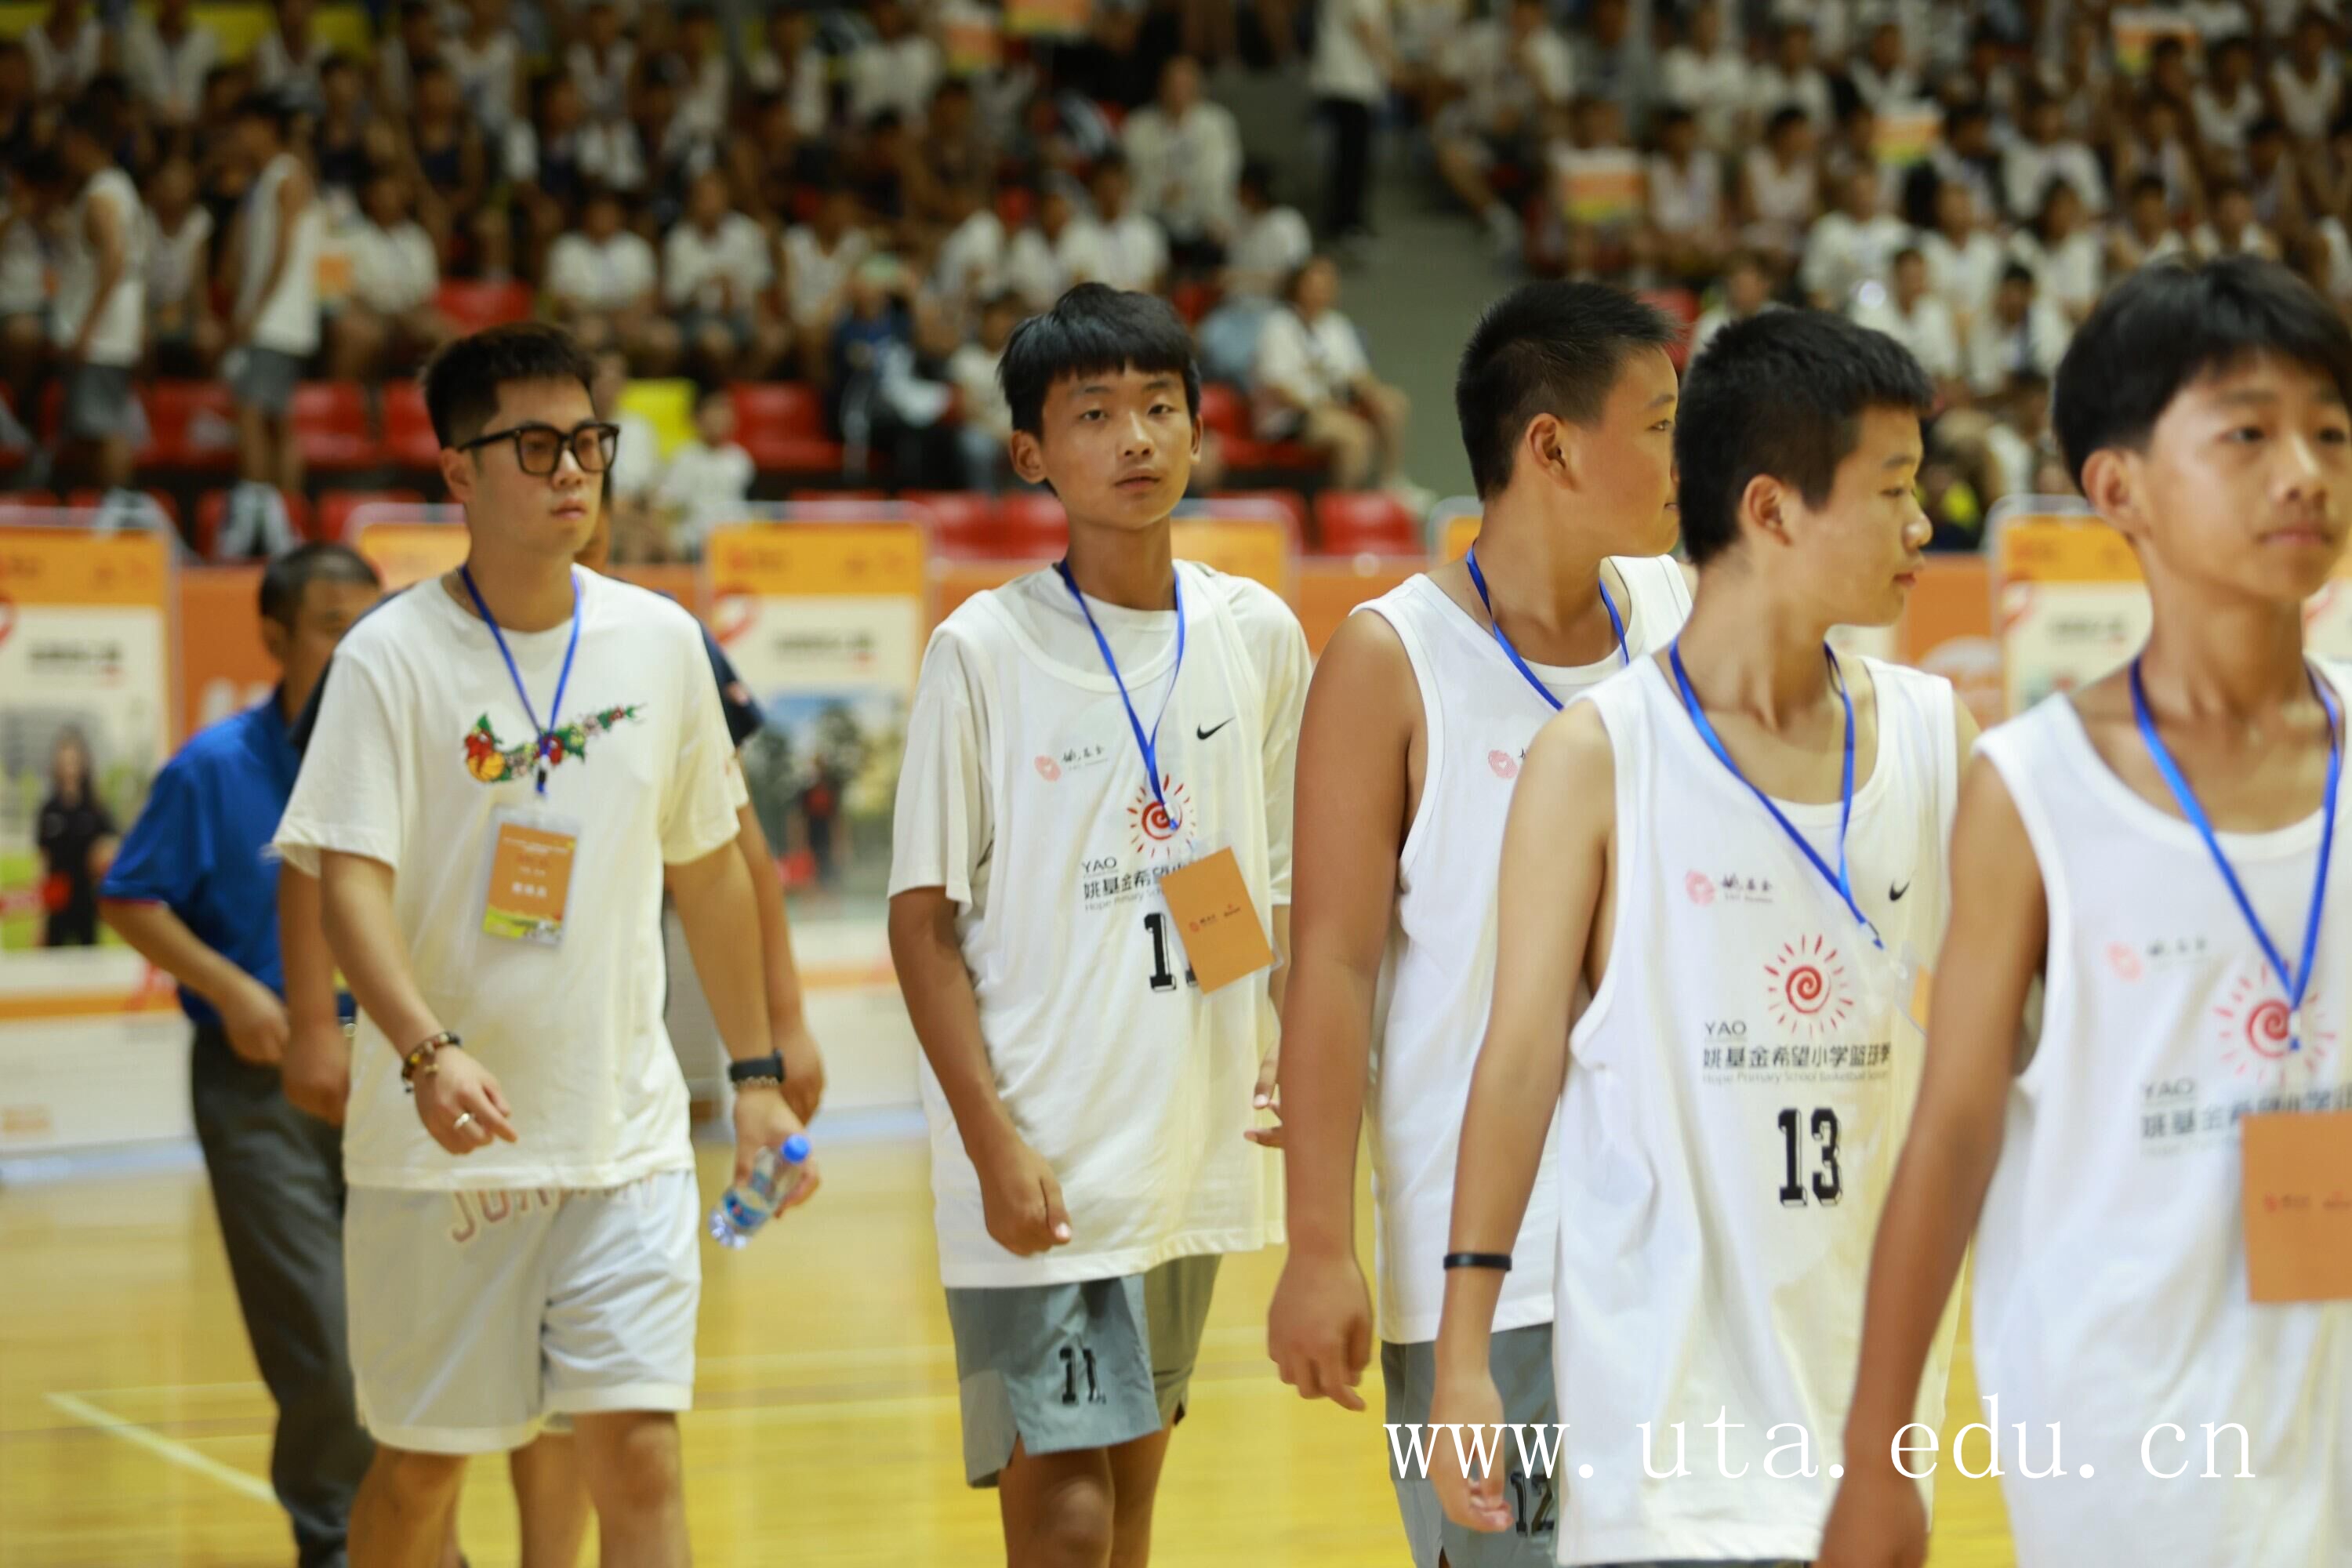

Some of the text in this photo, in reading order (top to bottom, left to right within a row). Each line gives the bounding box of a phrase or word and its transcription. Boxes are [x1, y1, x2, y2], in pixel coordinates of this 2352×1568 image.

[1082, 856, 1117, 873] YAO
[1144, 913, 1197, 992] 1
[1704, 1021, 1748, 1035] YAO
[1737, 1070, 1780, 1083] Primary
[1777, 1107, 1842, 1207] 13
[1059, 1347, 1106, 1406] 11
[1510, 1472, 1555, 1537] 12
